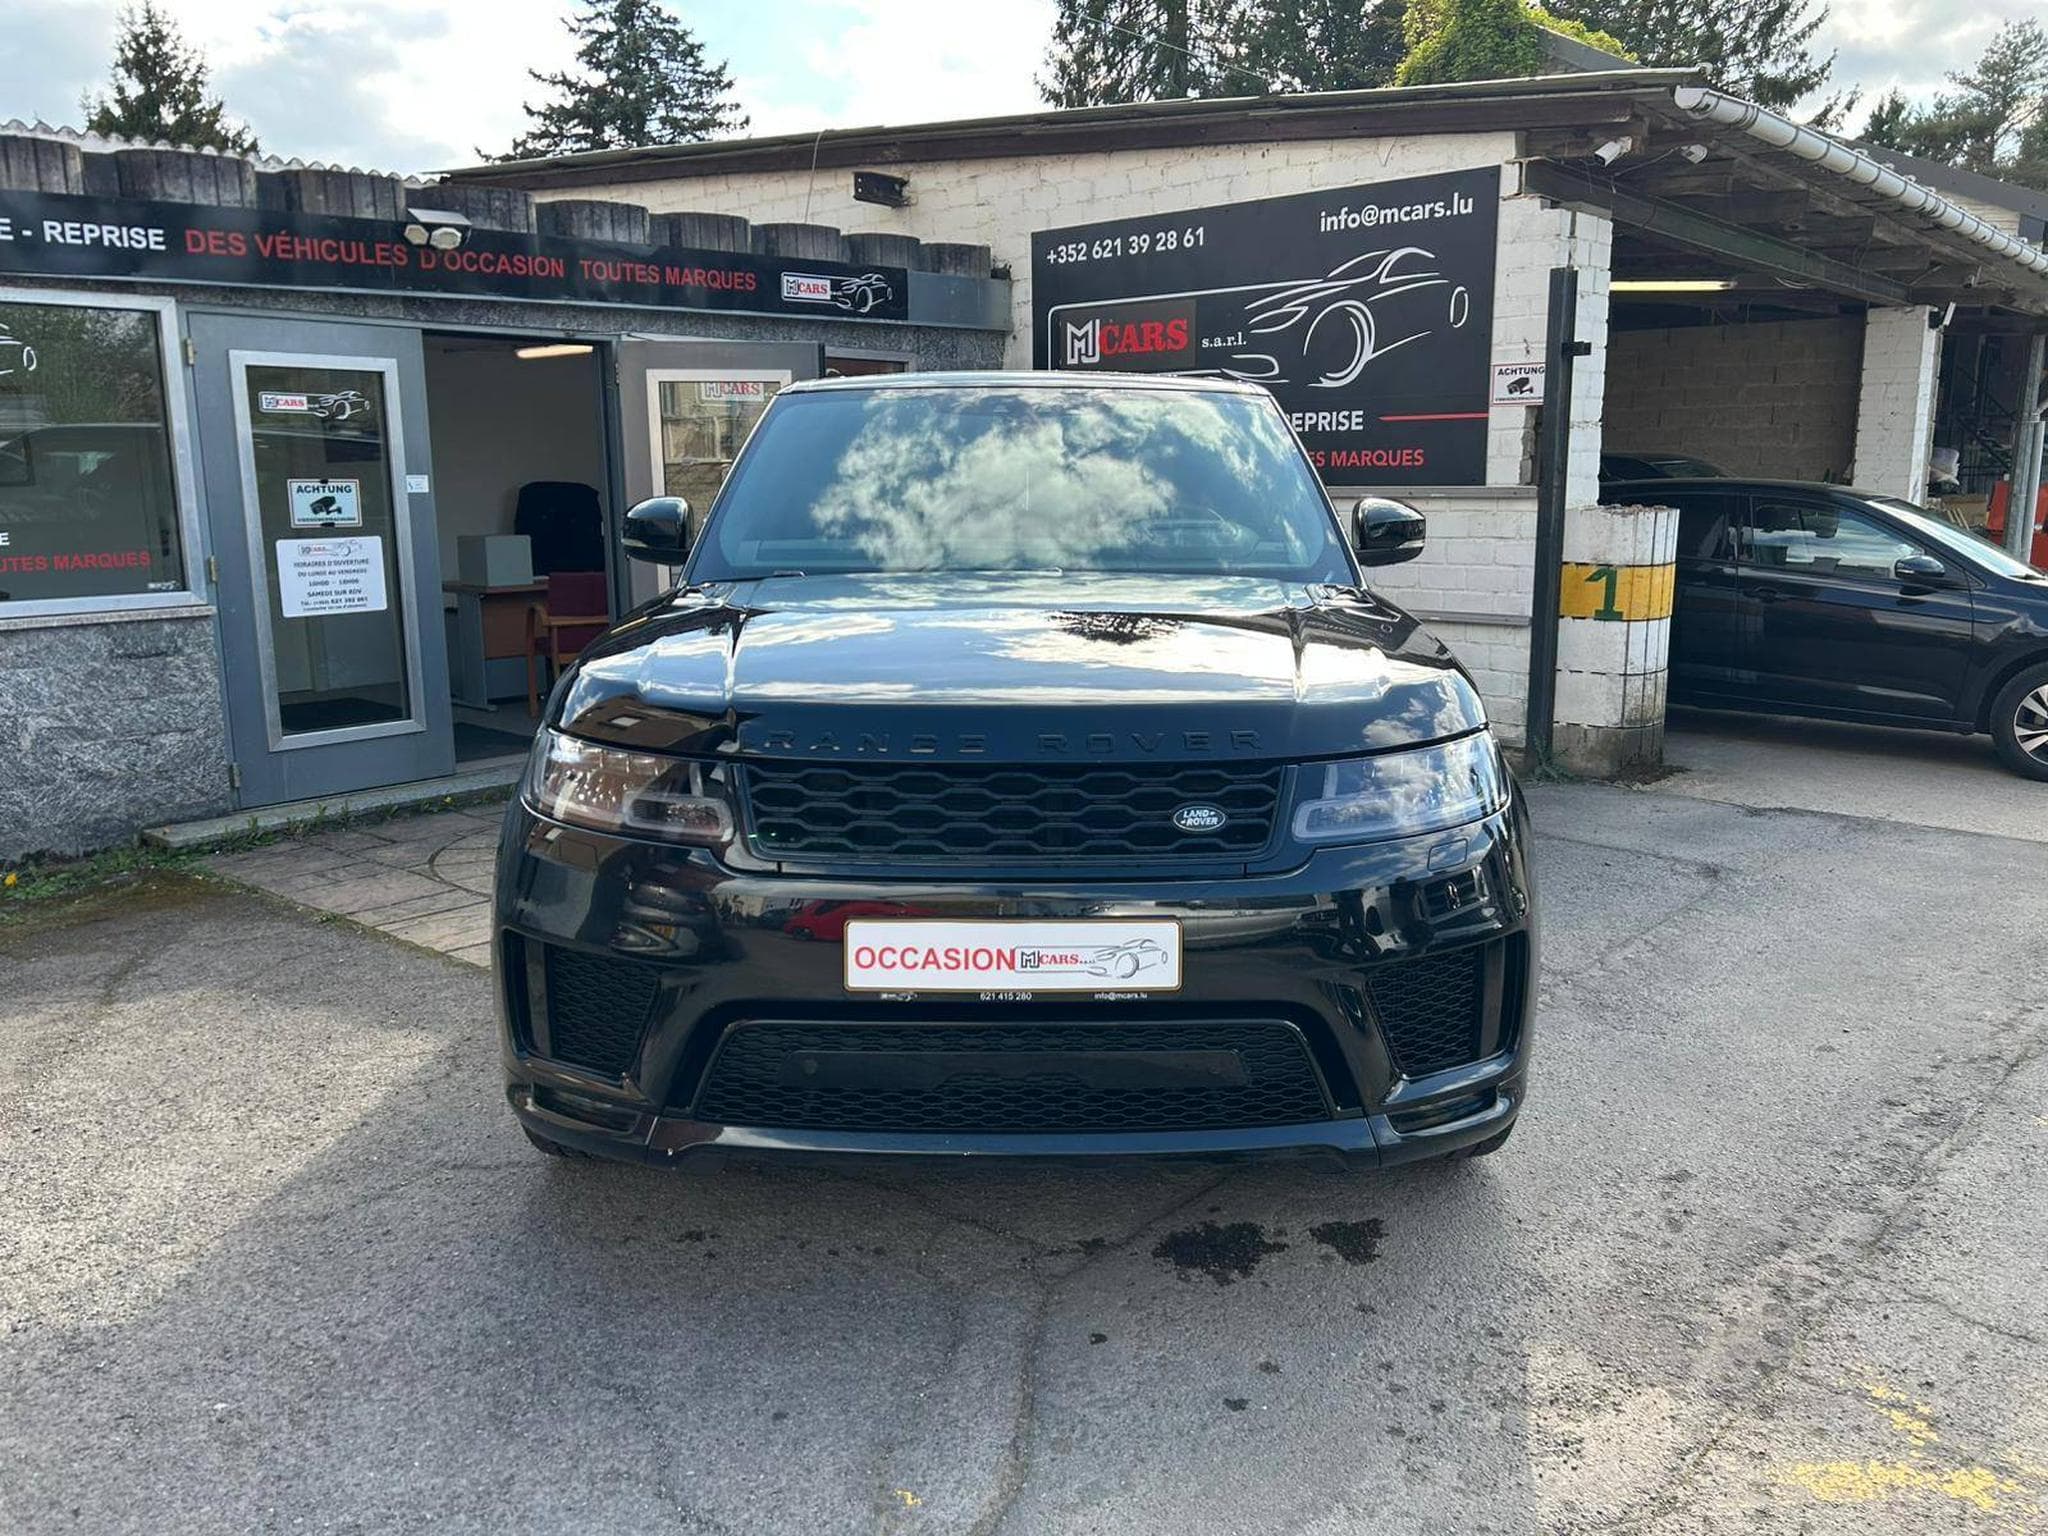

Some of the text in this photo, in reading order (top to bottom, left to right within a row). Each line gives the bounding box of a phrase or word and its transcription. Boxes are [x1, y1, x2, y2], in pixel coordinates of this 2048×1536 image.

[1320, 192, 1474, 232] info@mcars.lu
[43, 220, 166, 250] REPRISE
[185, 229, 247, 256] DES
[255, 230, 408, 267] VÉHICULES
[579, 260, 660, 284] TOUTES
[665, 266, 757, 291] MARQUES
[1047, 226, 1204, 264] +352 621 39 28 61
[1100, 318, 1189, 355] CARS
[1202, 332, 1247, 348] s.a.r.l.
[1497, 366, 1545, 376] ACHTUNG
[721, 382, 760, 396] CARS
[1286, 410, 1364, 432] EPRISE
[1331, 448, 1425, 467] MARQUES
[296, 484, 352, 494] ACHTUNG
[53, 550, 151, 571] MARQUES
[1585, 567, 1624, 621] 1
[761, 729, 1264, 753] RANGE ROVER
[1186, 817, 1218, 827] ROVER
[854, 946, 1016, 971] OCCASION
